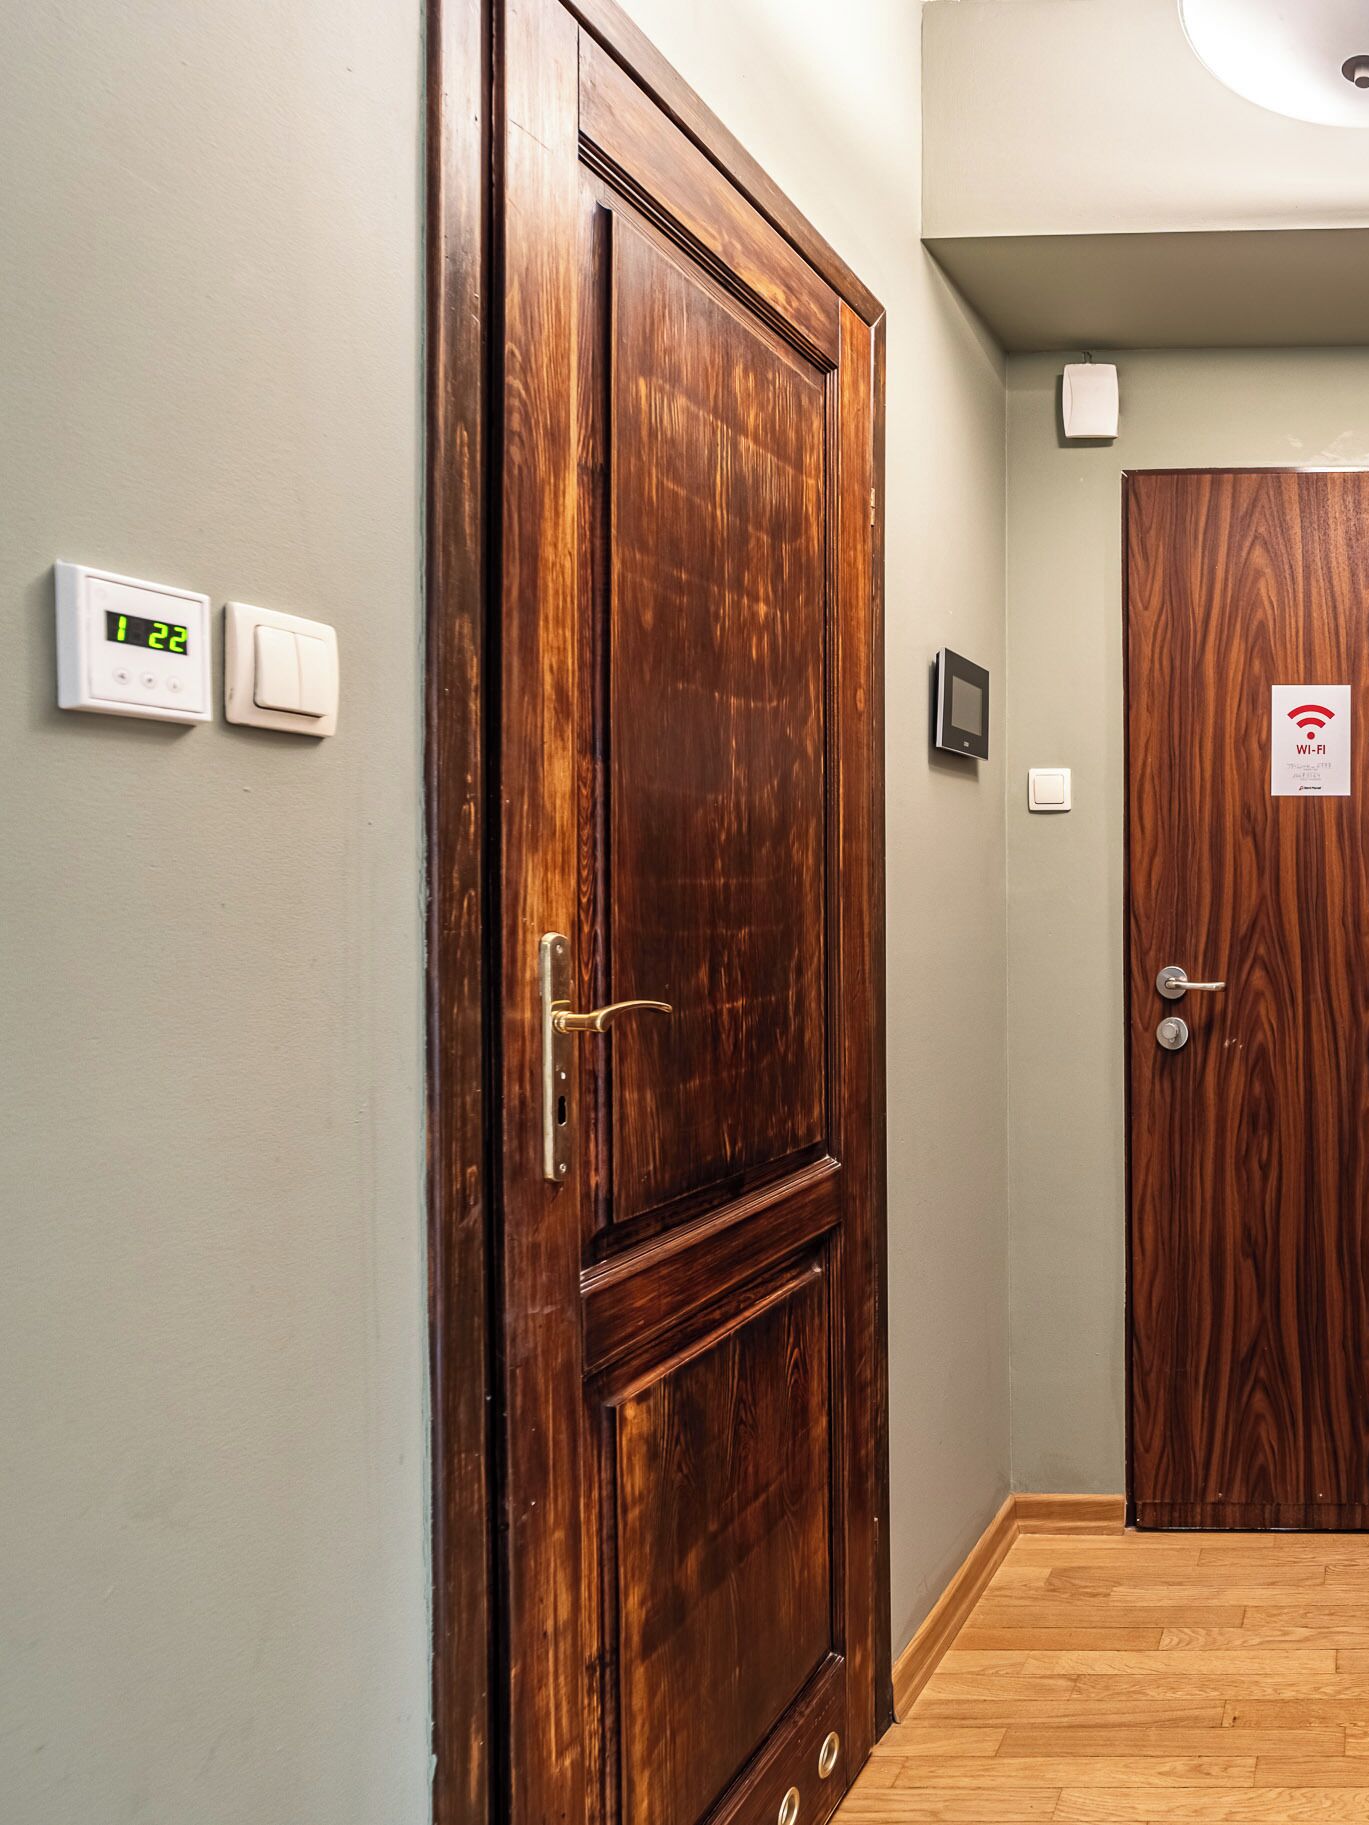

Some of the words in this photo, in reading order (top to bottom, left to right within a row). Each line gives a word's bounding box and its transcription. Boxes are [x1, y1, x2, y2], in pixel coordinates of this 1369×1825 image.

[118, 616, 127, 641] 1
[148, 622, 188, 652] 22
[1296, 744, 1326, 755] WI-FI
